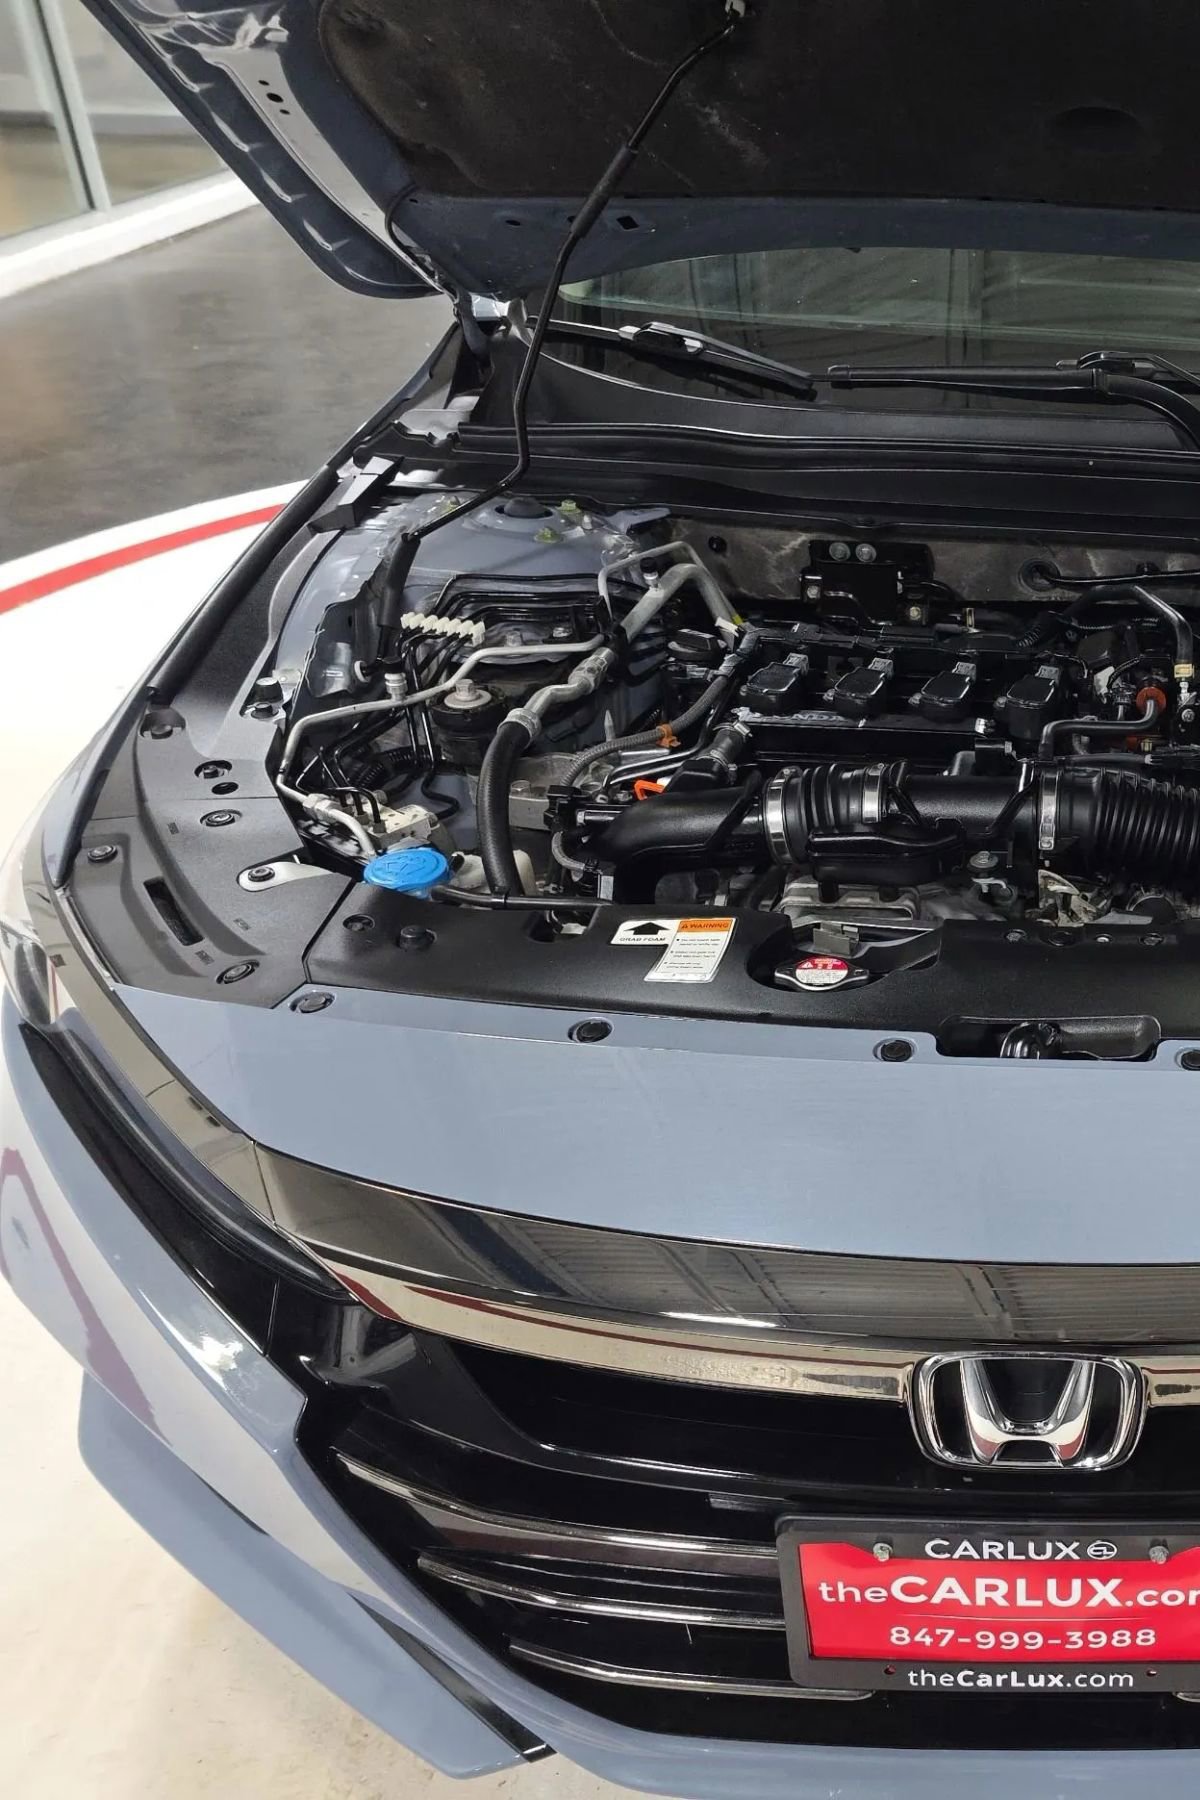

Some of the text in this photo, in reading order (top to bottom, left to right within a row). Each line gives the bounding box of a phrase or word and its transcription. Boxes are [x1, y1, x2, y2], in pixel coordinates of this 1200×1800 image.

[924, 1539, 1081, 1561] CARLUX
[889, 1627, 1156, 1650] 847-999-3988
[907, 1669, 1134, 1688] theCarLux.com
